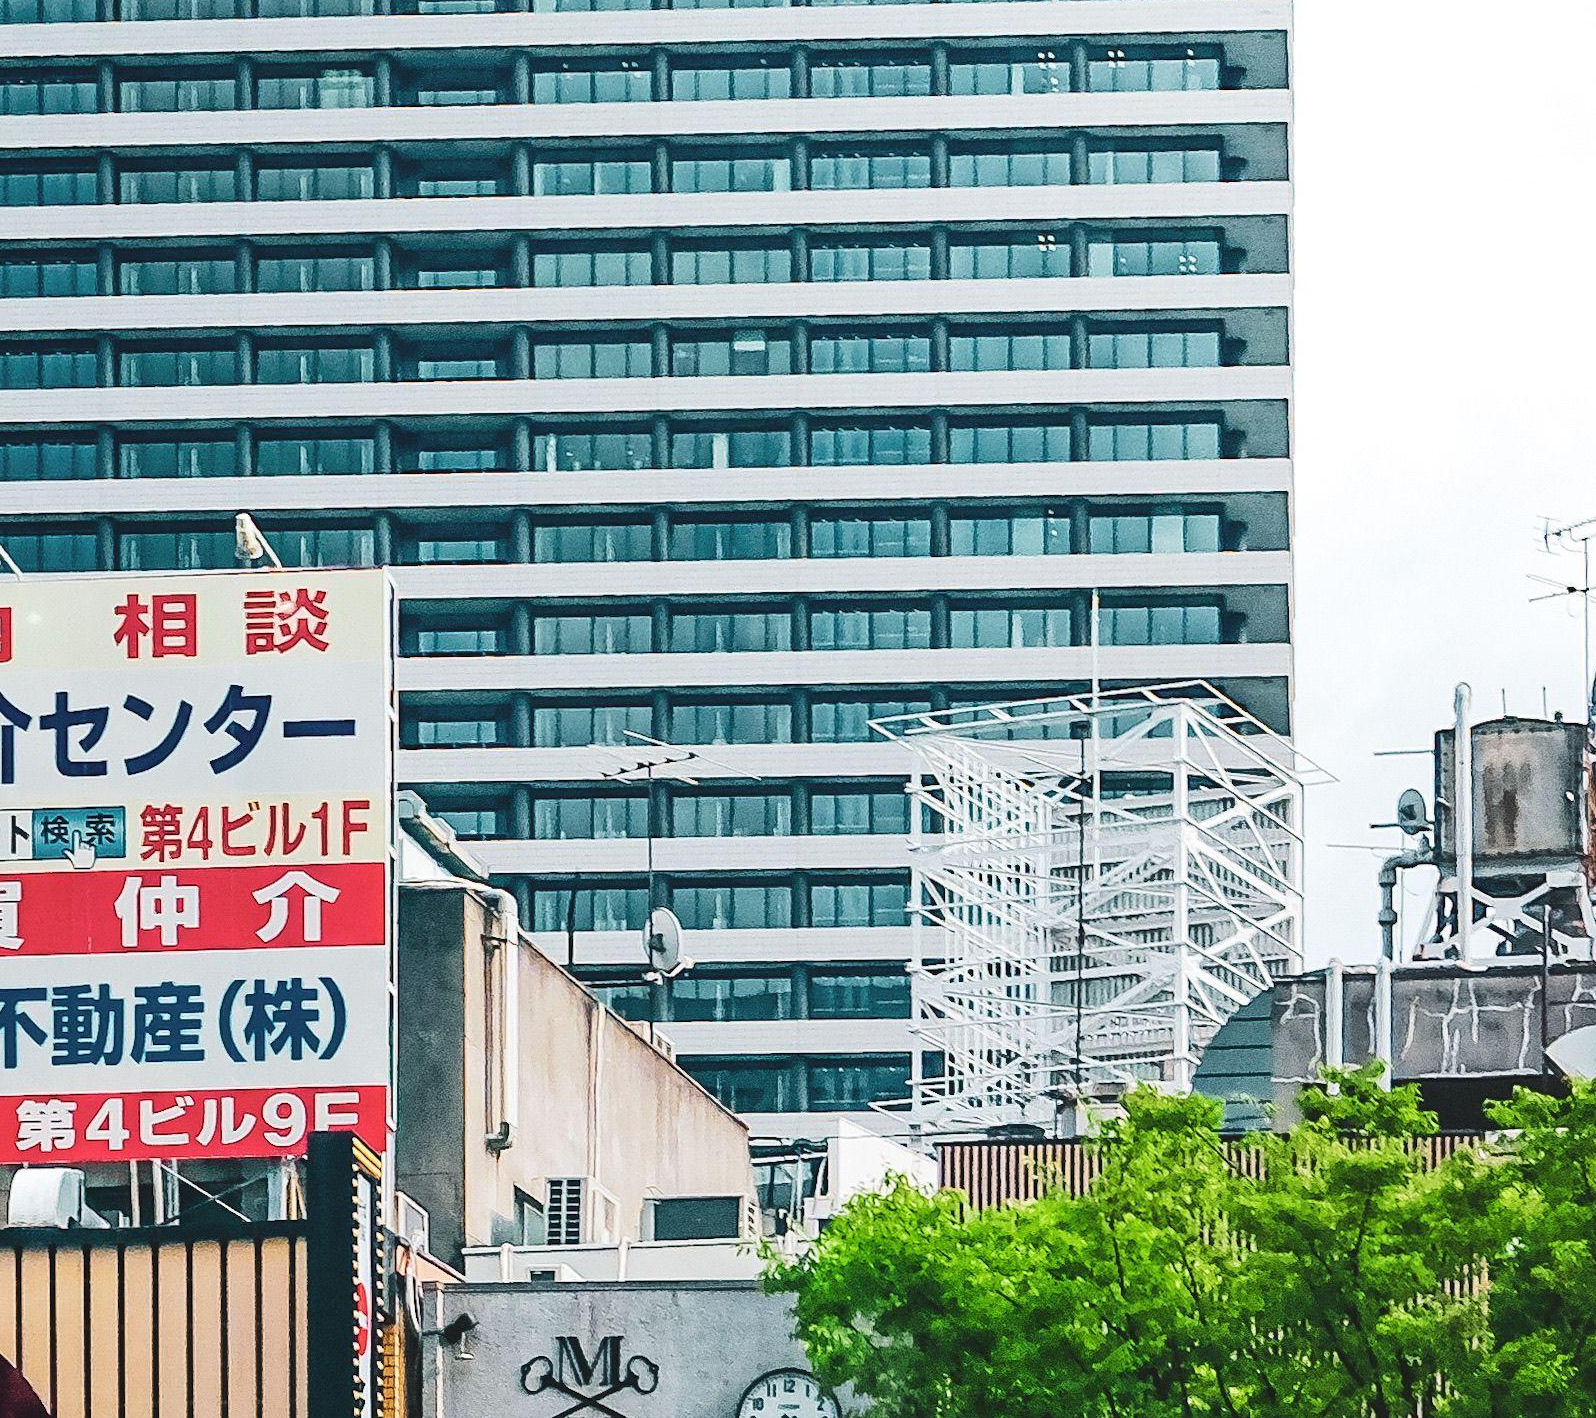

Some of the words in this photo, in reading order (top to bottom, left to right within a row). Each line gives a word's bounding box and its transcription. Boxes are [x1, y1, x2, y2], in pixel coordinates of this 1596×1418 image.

[113, 585, 334, 662] 相談
[39, 812, 117, 850] 検索
[138, 799, 373, 864] 第4ビル1F
[114, 869, 342, 951] 仲介
[15, 1089, 361, 1156] 第4ビル9F
[555, 1335, 626, 1387] M
